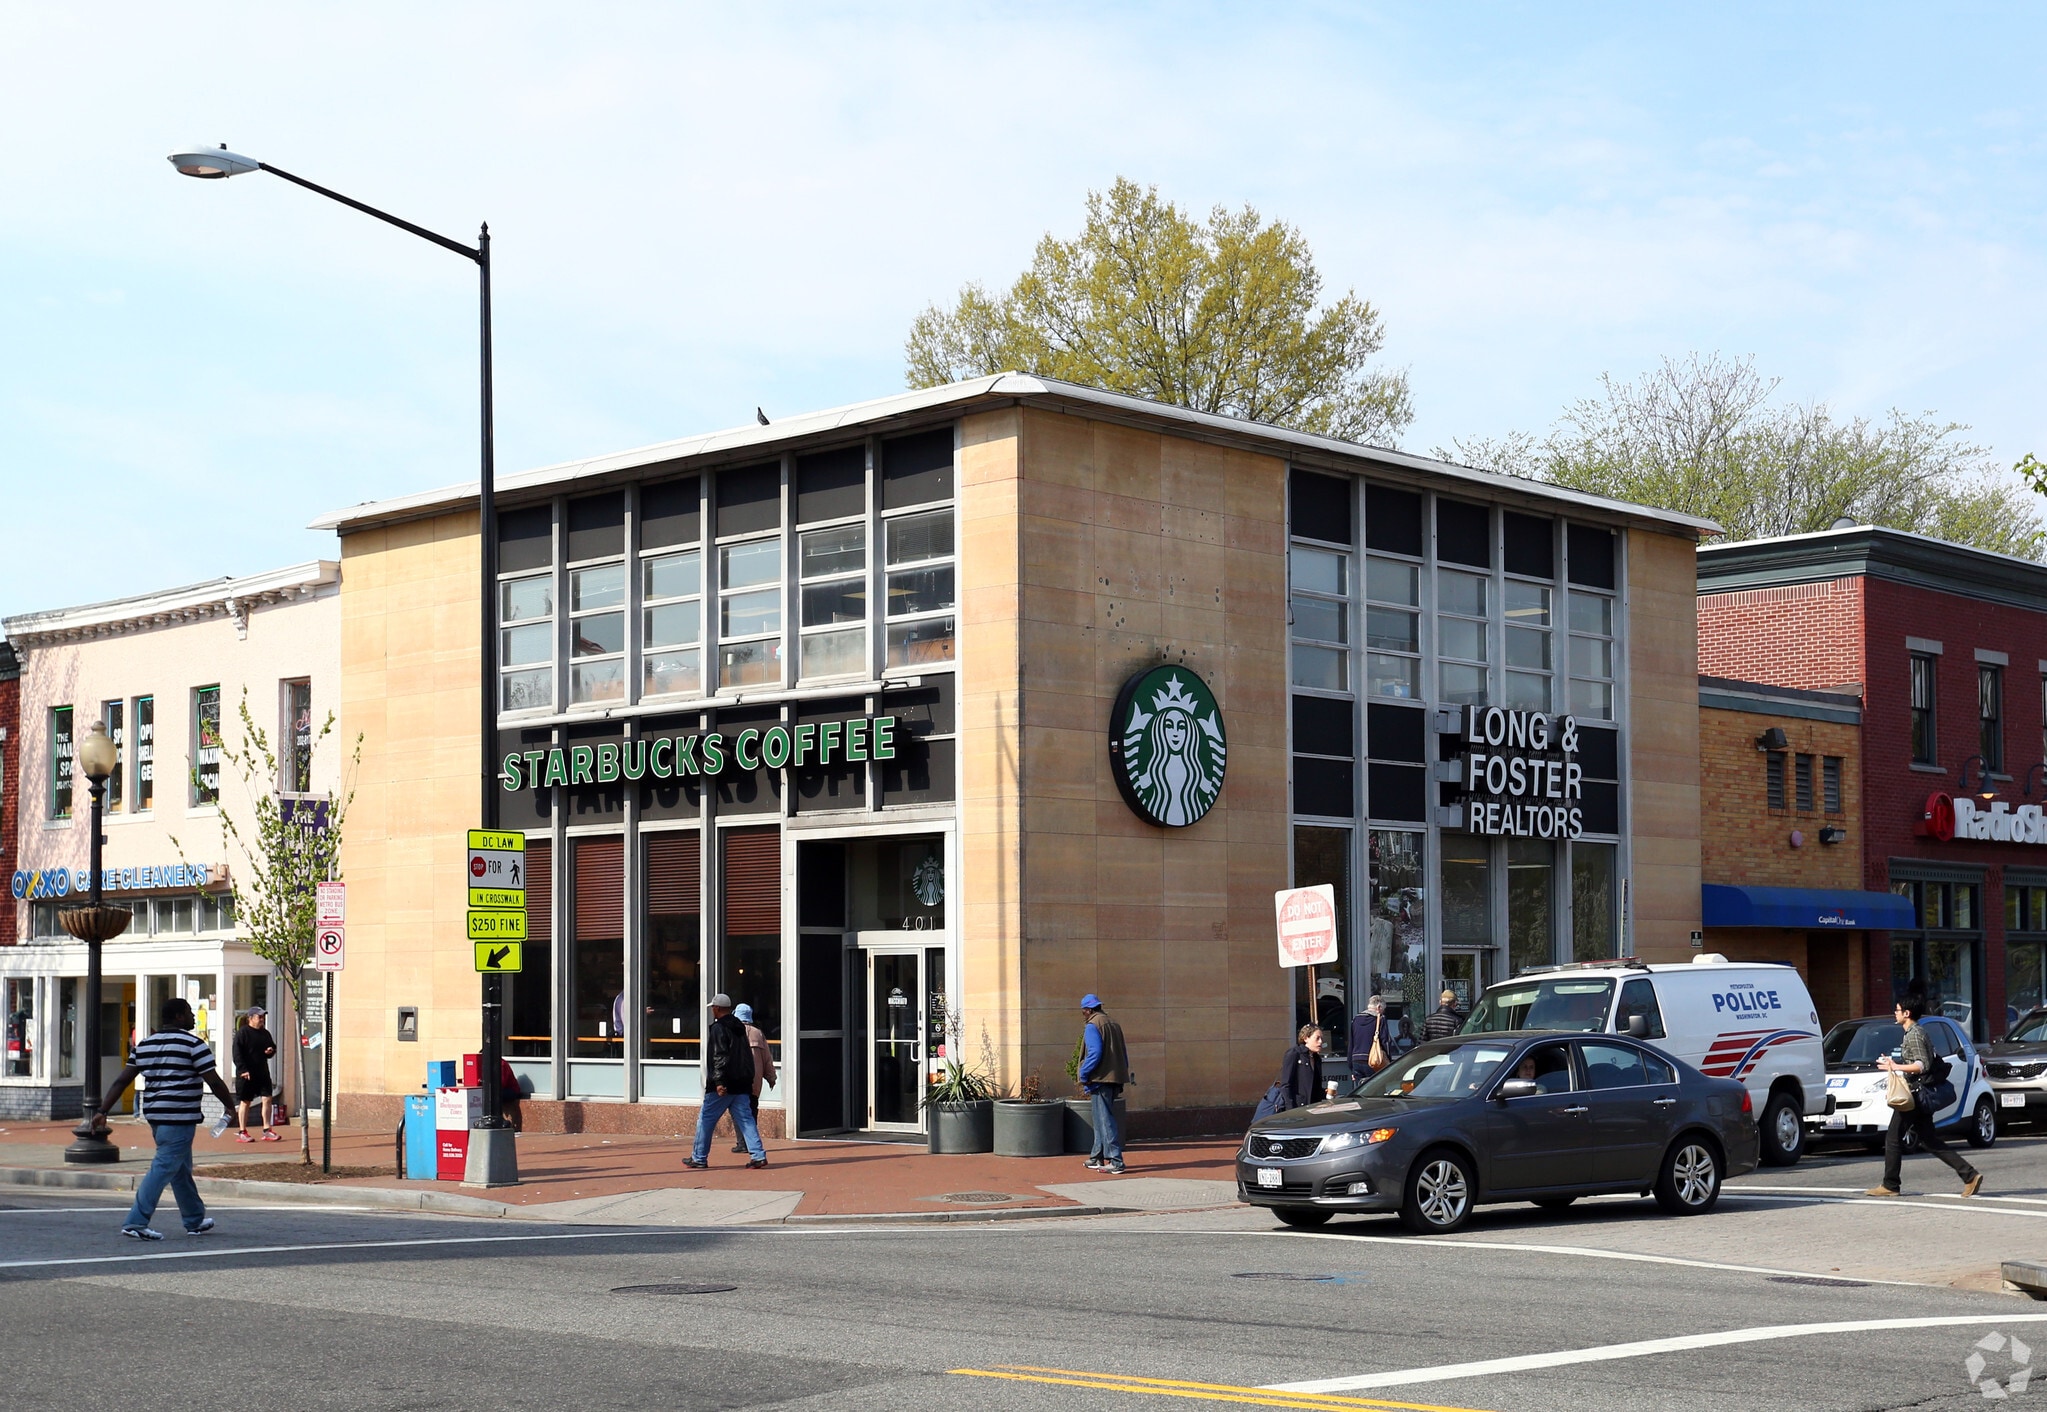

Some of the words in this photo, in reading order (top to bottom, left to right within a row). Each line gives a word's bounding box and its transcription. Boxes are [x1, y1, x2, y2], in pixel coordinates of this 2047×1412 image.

[1468, 704, 1549, 751] LONG
[1561, 715, 1580, 753] &
[56, 733, 69, 743] THE
[502, 732, 725, 792] STARBUCKS
[735, 715, 896, 771] COFFEE
[1468, 753, 1583, 800] FOSTER
[1470, 801, 1583, 840] REALTORS
[482, 836, 494, 849] DC
[496, 837, 515, 849] LAW
[473, 864, 484, 872] STOP
[488, 859, 503, 875] FOR
[11, 866, 70, 899] OXXO
[120, 863, 207, 891] CLEANERS
[476, 893, 484, 904] IN
[485, 894, 520, 906] CROSSWALK
[1287, 904, 1301, 917] DO
[1303, 901, 1323, 915] NOT
[472, 917, 496, 933] $250
[500, 918, 521, 932] FINE
[902, 916, 936, 932] 401
[1292, 935, 1323, 952] ENTER
[1711, 990, 1782, 1013] POLICE
